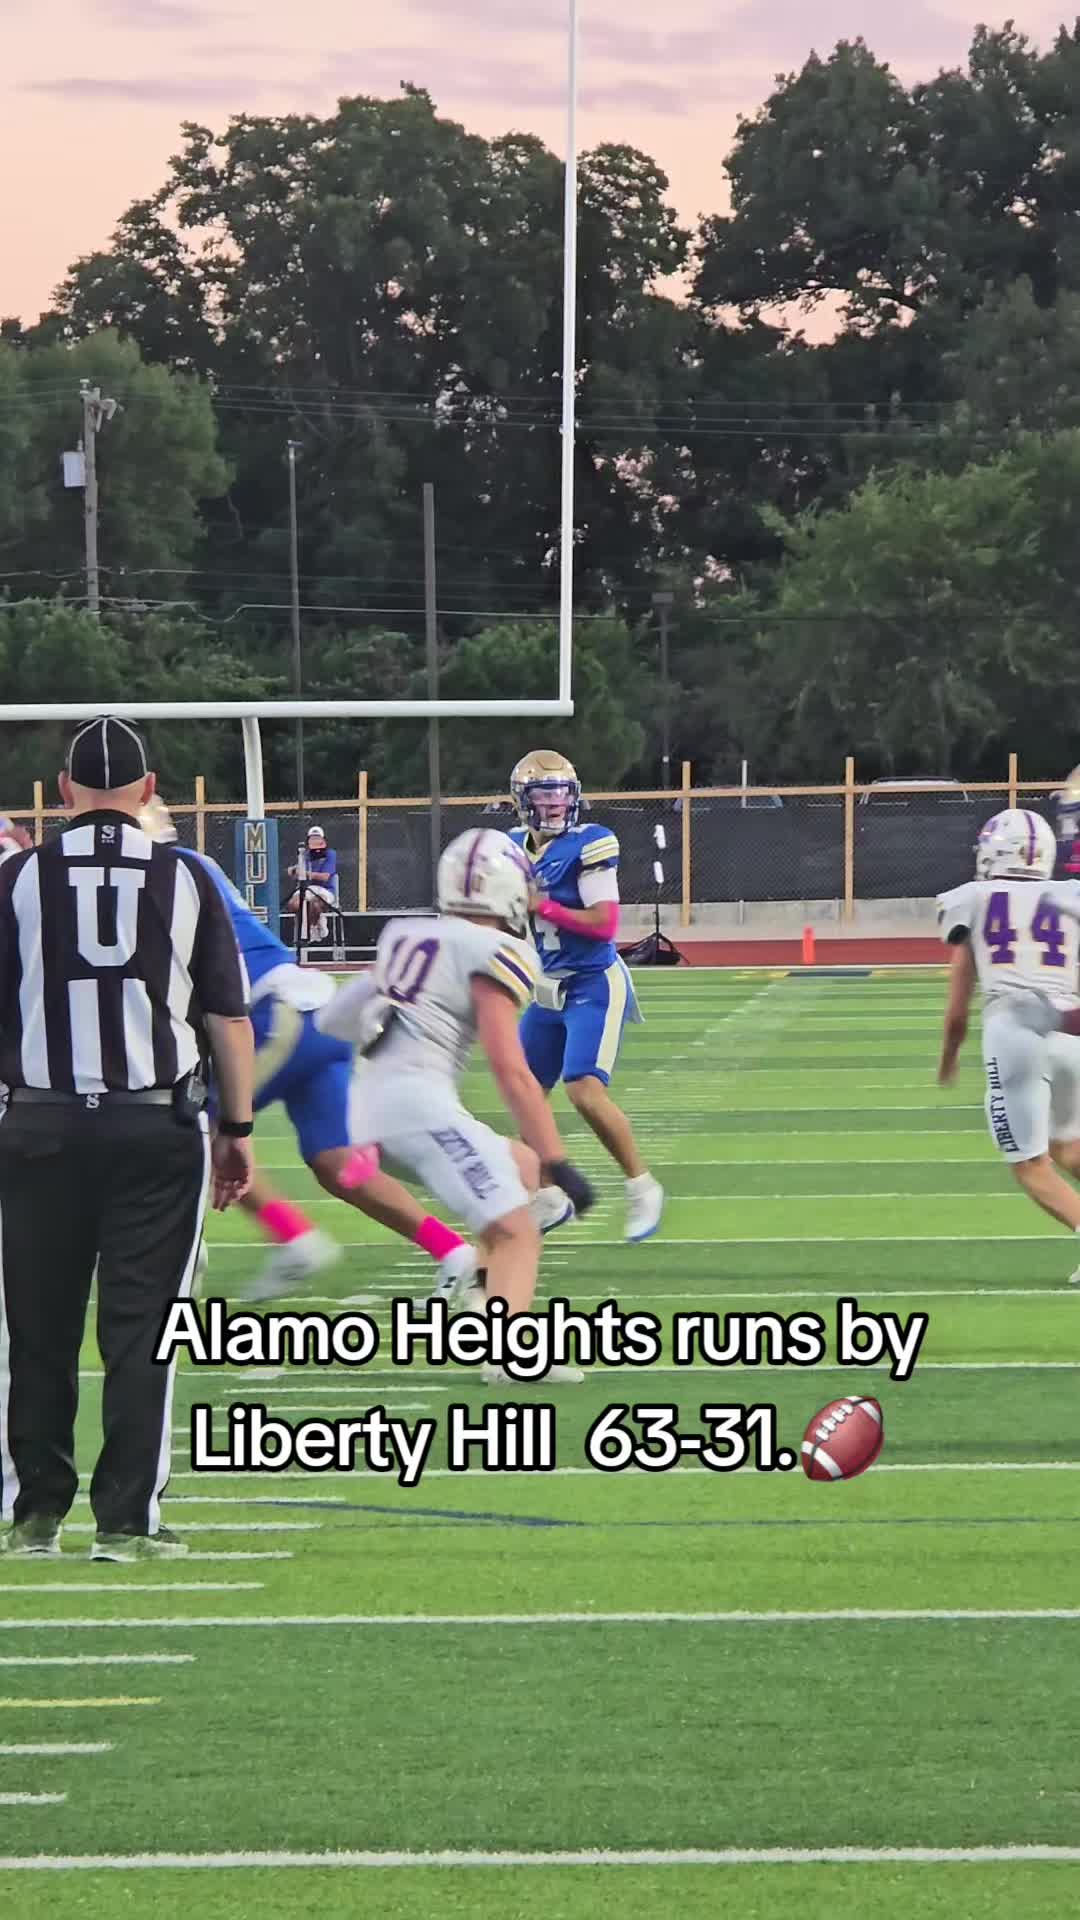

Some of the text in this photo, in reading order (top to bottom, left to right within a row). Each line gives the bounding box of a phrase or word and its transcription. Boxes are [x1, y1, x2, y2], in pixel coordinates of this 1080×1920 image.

[68, 866, 146, 967] U
[244, 822, 268, 923] MUL
[983, 891, 1067, 968] 44
[986, 1056, 1020, 1152] LIBERTY HILL
